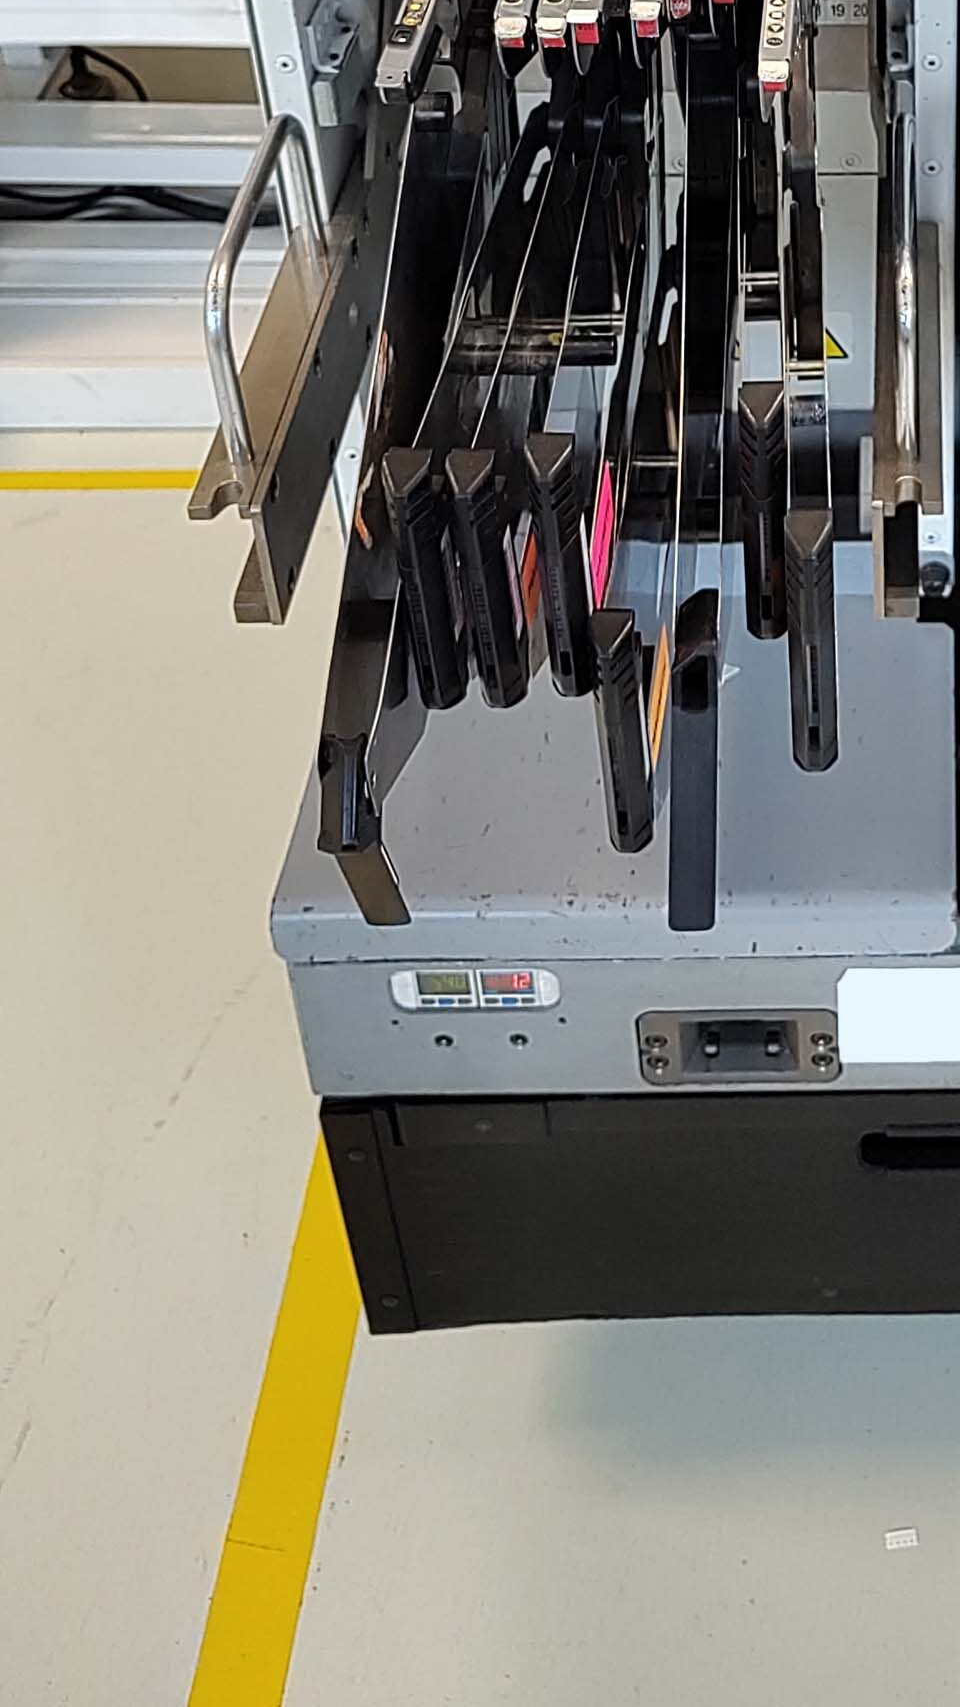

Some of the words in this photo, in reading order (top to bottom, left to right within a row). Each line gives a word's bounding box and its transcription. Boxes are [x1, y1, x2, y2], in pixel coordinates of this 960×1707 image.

[831, 3, 846, 18] 19
[853, 4, 868, 18] 20
[512, 973, 530, 989] 12
